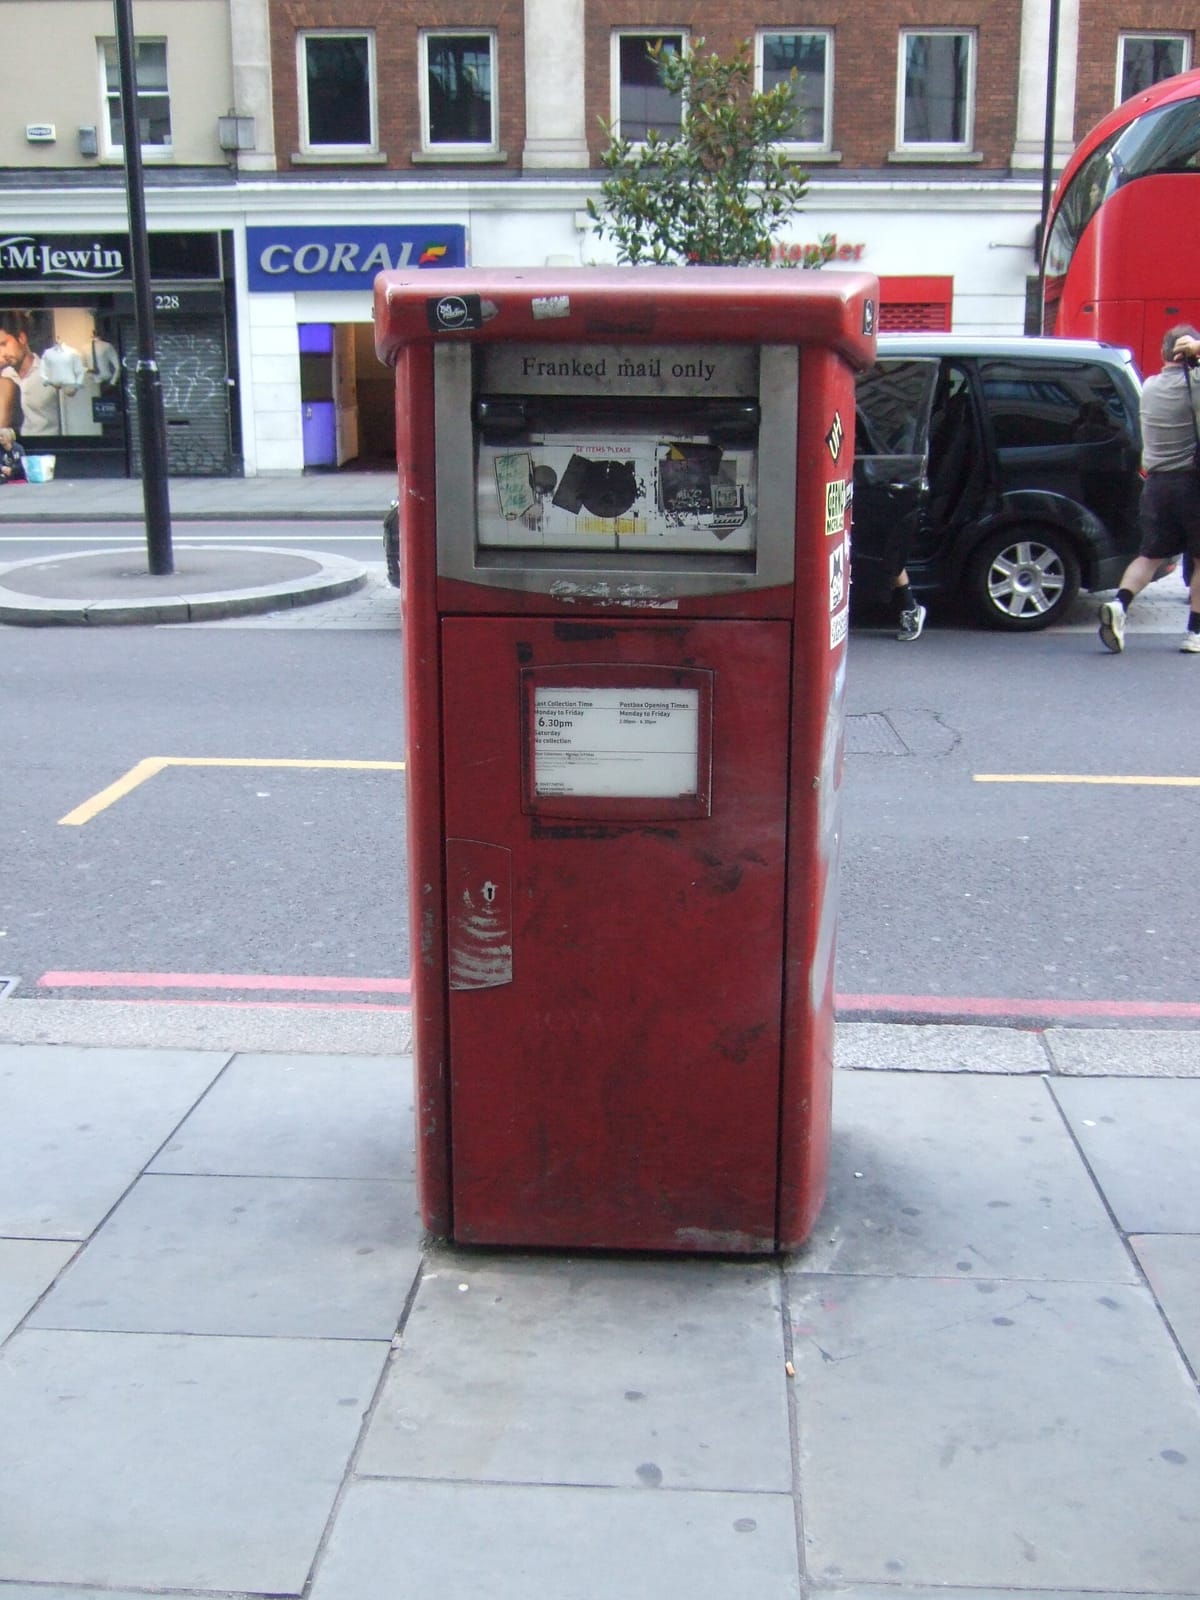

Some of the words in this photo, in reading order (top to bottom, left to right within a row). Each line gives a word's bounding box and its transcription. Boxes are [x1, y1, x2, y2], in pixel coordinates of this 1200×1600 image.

[260, 242, 419, 274] CORAL
[155, 296, 179, 309] 228
[522, 357, 606, 377] Franked
[617, 359, 661, 377] mail
[671, 360, 716, 381] only
[538, 717, 573, 728] 6.30pm
